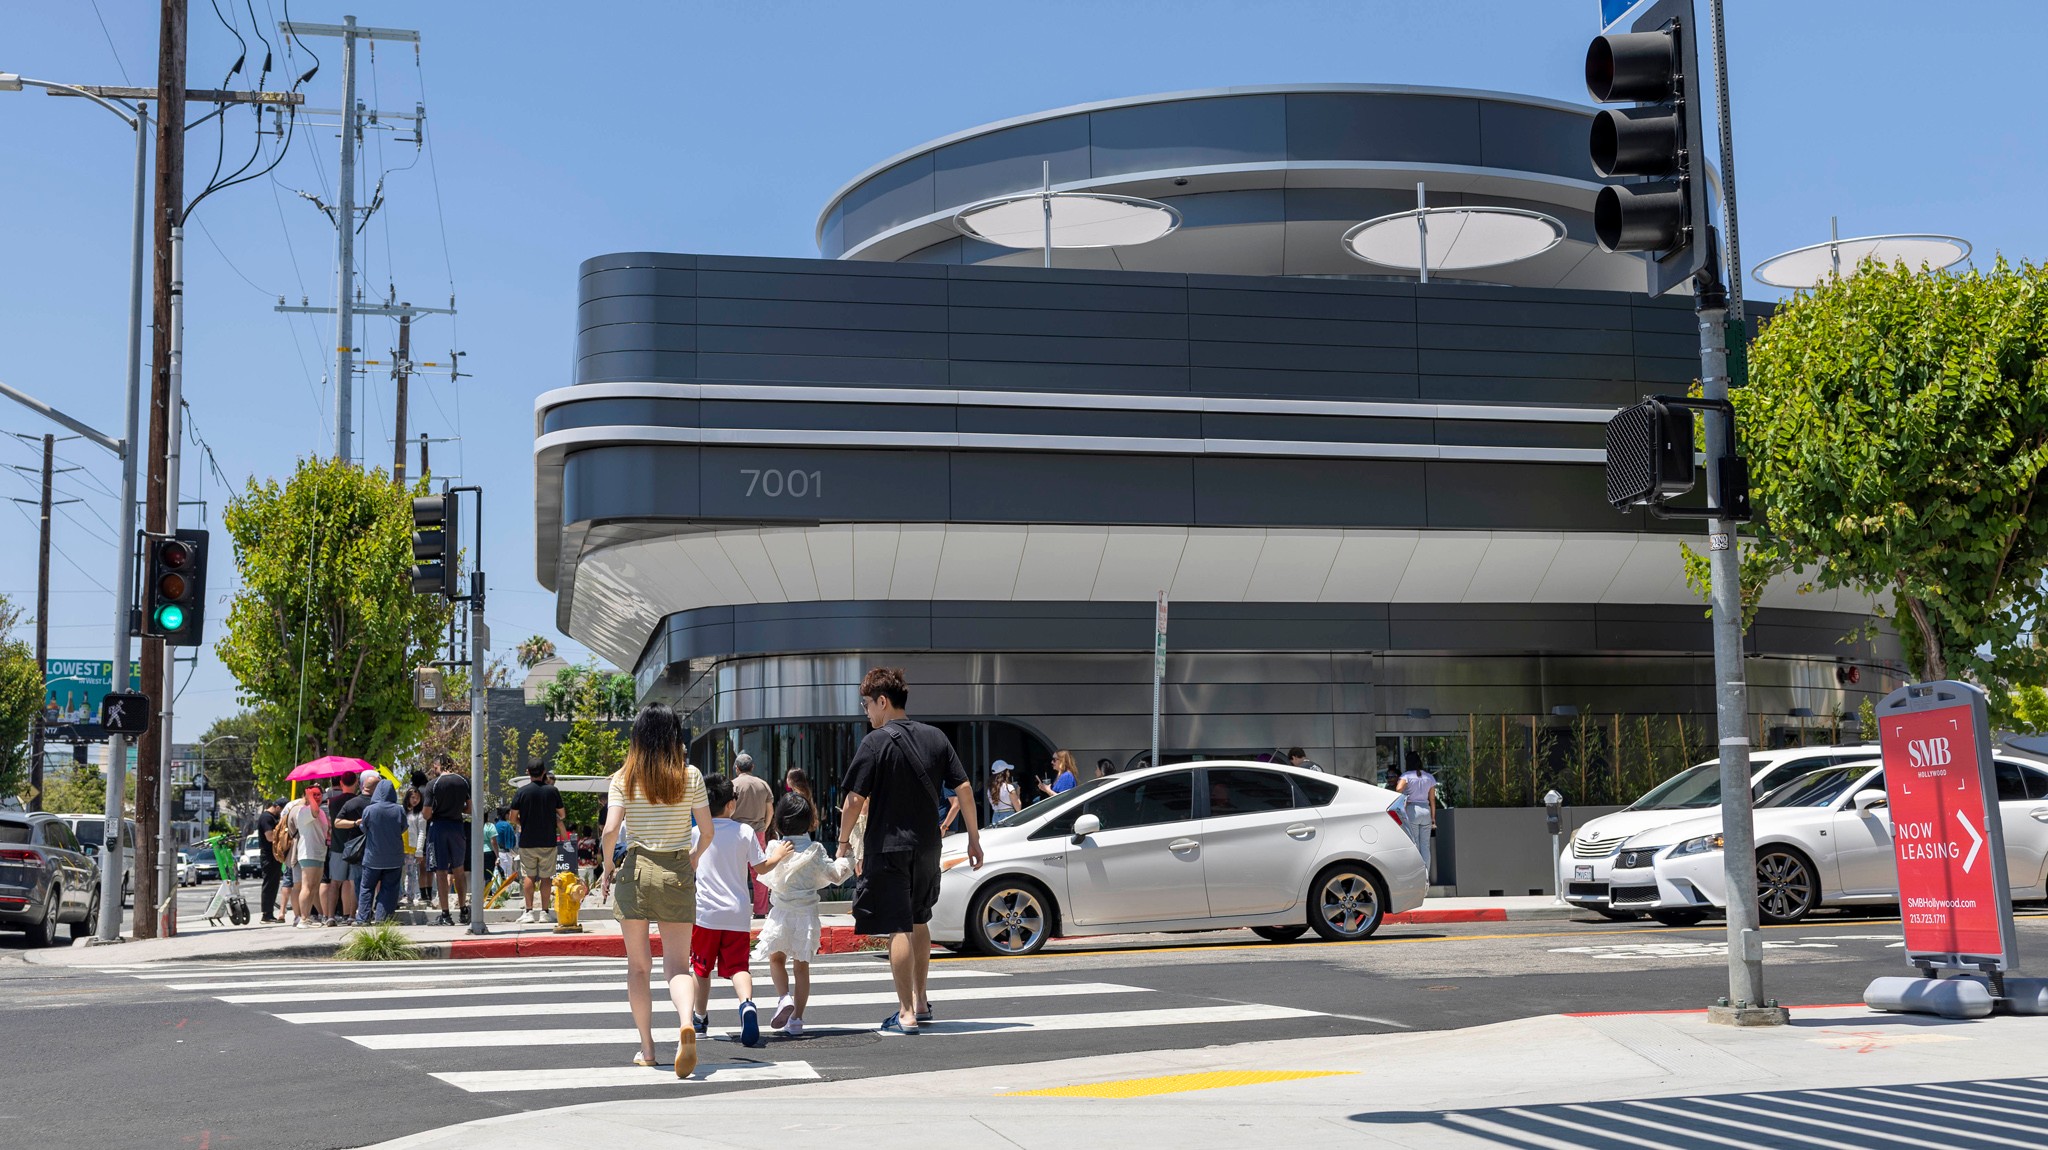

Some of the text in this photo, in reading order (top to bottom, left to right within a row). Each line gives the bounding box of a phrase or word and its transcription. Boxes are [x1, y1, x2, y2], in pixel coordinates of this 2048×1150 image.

[740, 469, 822, 498] 7001
[46, 661, 100, 676] LOWEST
[1908, 737, 1952, 768] SMB
[1917, 769, 1947, 778] HOLLYWOOD
[1899, 822, 1932, 840] NOW
[1901, 842, 1960, 860] LEASING
[1907, 897, 1977, 911] SMBHollywood.com
[1909, 913, 1946, 924] 213.723.1711
